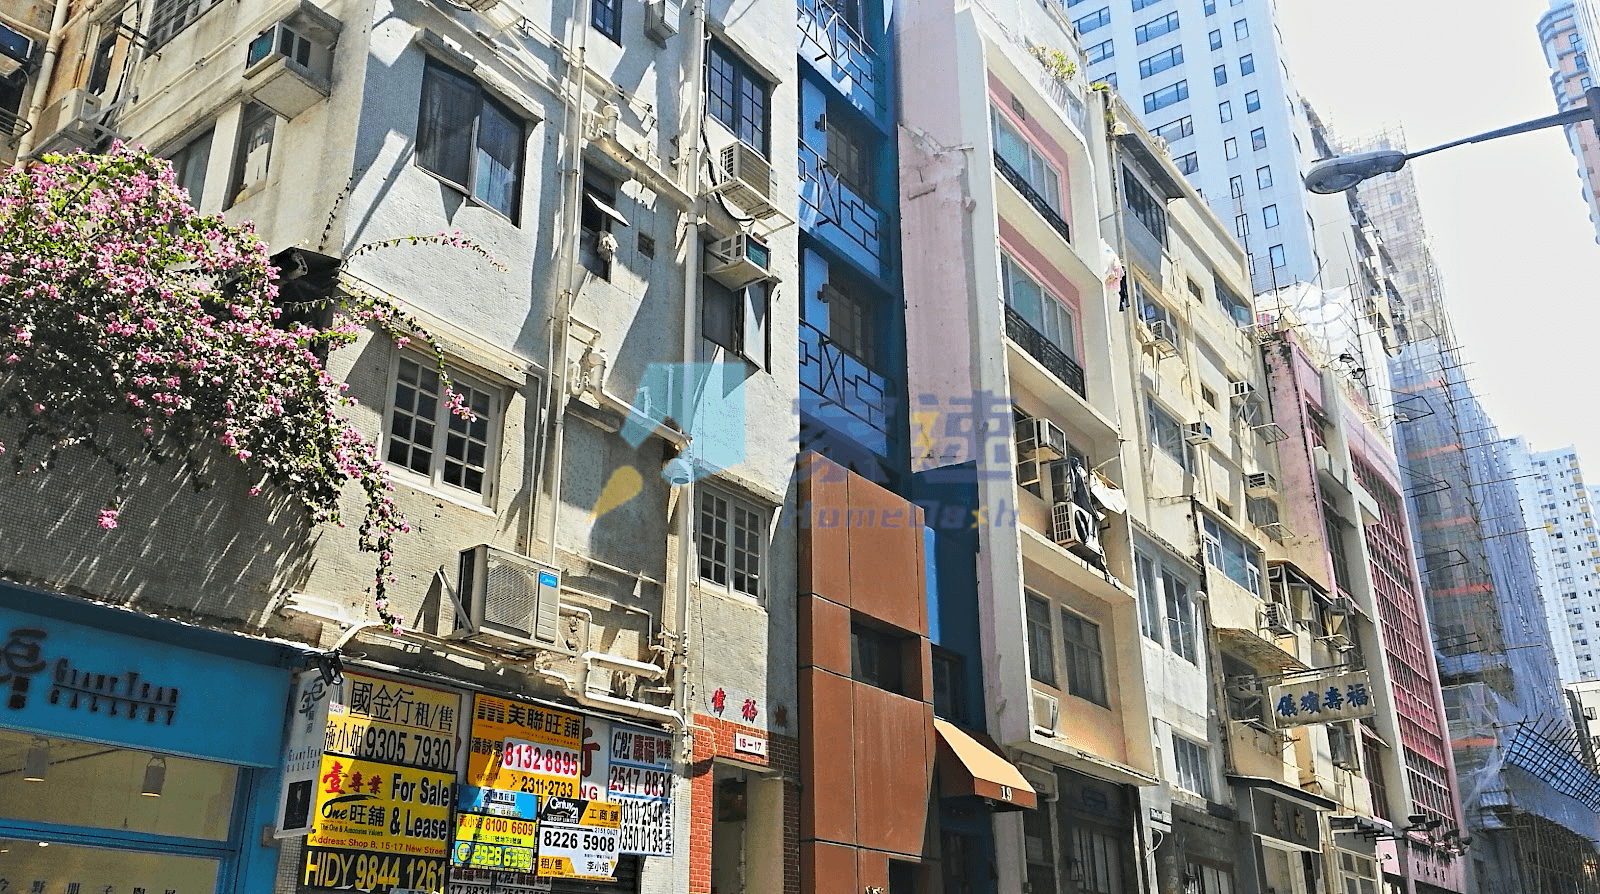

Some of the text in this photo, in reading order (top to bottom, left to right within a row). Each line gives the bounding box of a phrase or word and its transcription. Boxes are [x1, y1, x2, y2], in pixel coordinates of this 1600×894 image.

[367, 728, 408, 762] 9305
[413, 735, 451, 770] 7930
[391, 772, 417, 802] For
[419, 777, 449, 807] Sale
[609, 765, 672, 798] 2517 8831
[1000, 785, 1013, 801] 19
[549, 796, 575, 811] Century
[389, 806, 447, 841] & Lease
[485, 818, 508, 833] 8100
[511, 822, 534, 836] 6609
[310, 835, 346, 846] Address:
[348, 838, 368, 849] Shop
[381, 841, 403, 851] 15-17
[405, 844, 418, 853] New
[418, 845, 447, 855] Street
[543, 830, 615, 853] 8226 5908
[304, 850, 447, 894] HIDY 9844 1261
